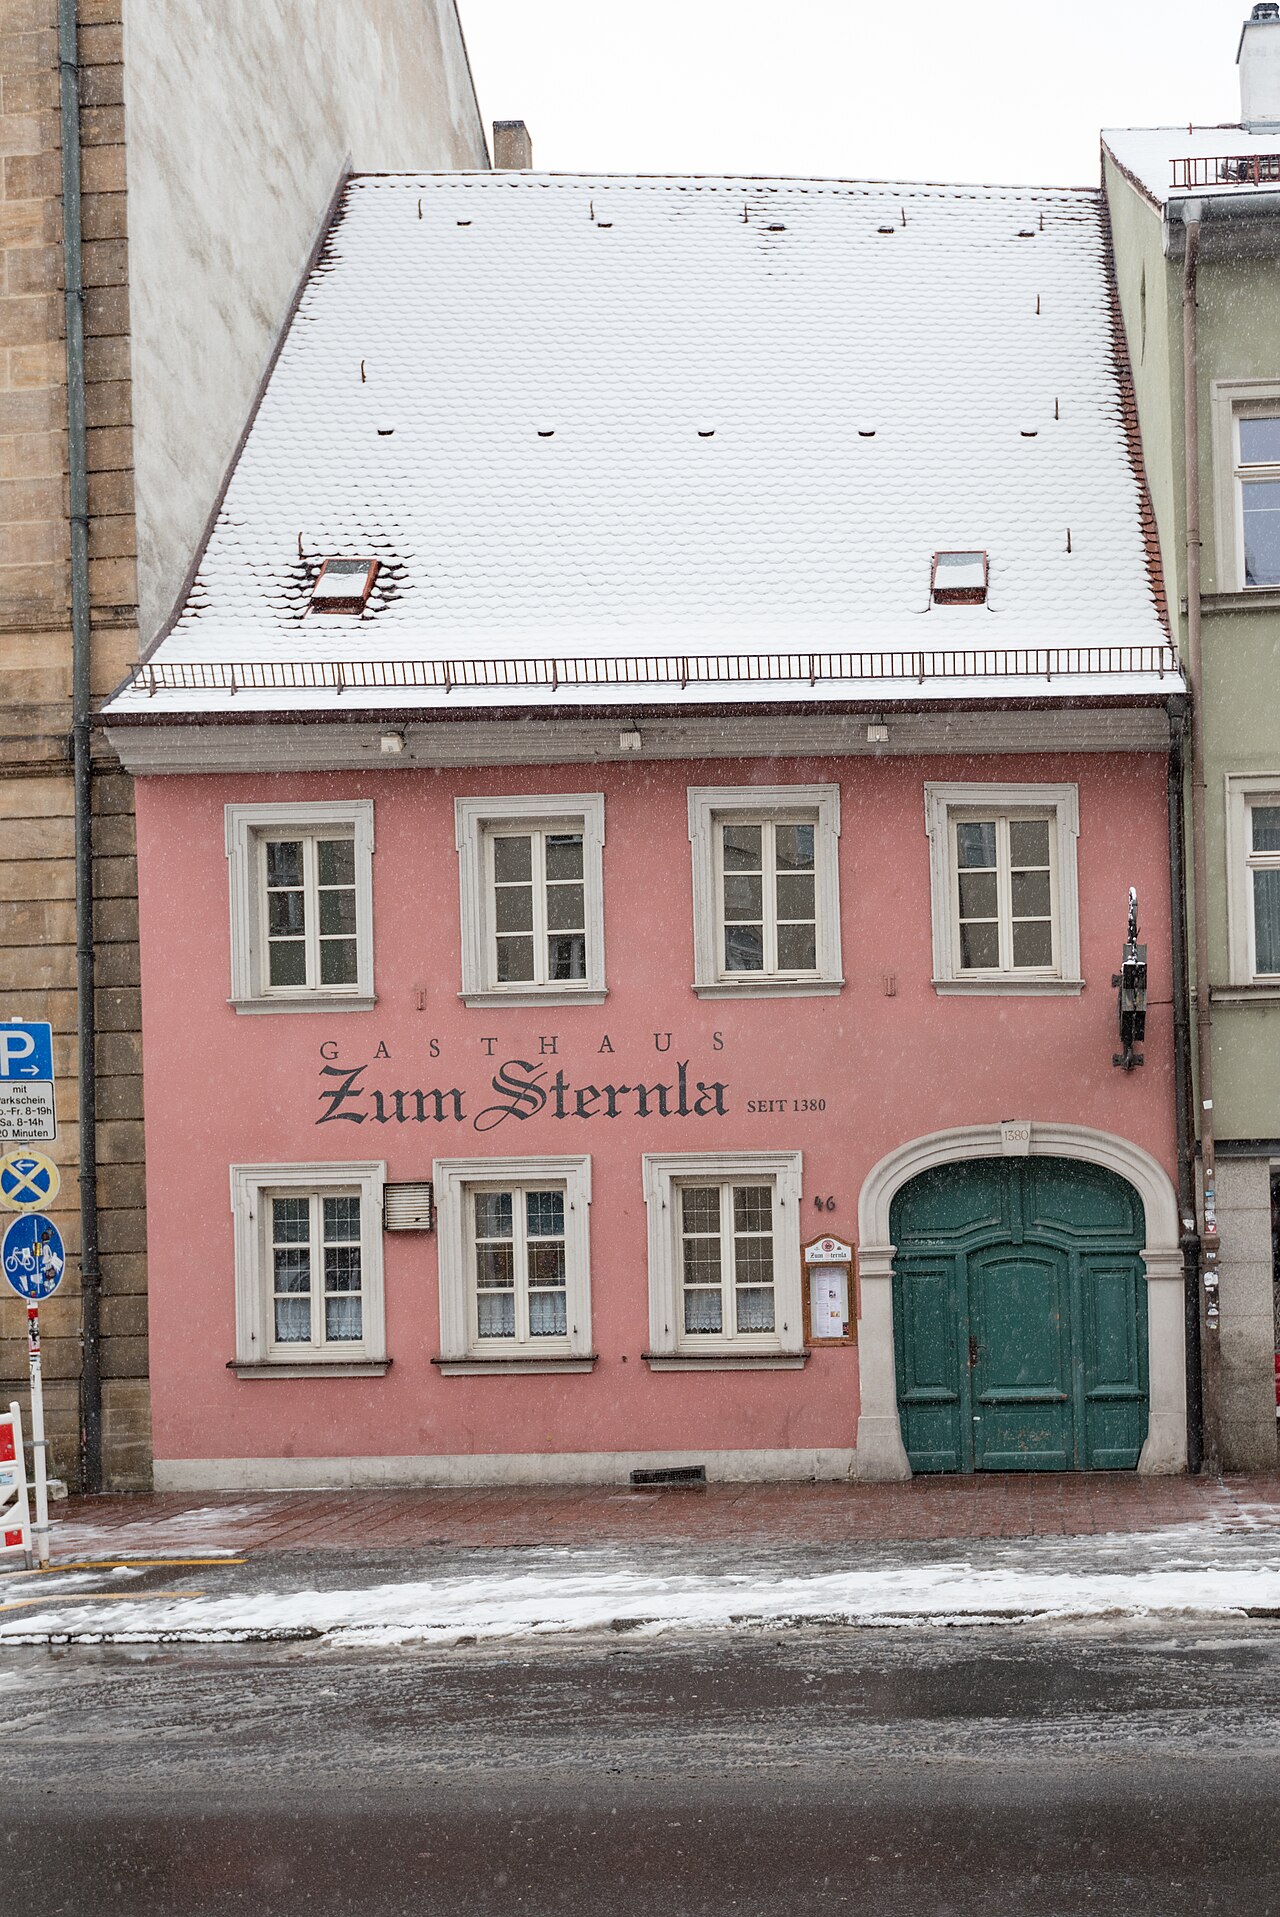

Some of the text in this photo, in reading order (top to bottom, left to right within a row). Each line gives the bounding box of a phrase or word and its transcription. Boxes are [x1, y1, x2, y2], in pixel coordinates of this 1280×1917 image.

[319, 1031, 725, 1061] GASTHAUS
[0, 1030, 35, 1076] P
[12, 1085, 27, 1093] mit
[0, 1096, 46, 1105] arkschein
[315, 1059, 826, 1132] Zum Sternla SEIT 1380
[25, 1107, 52, 1116] 8-19h
[17, 1117, 44, 1127] 8-14h
[12, 1129, 49, 1138] Minuten
[1004, 1130, 1029, 1141] 1380
[814, 1195, 836, 1212] 46
